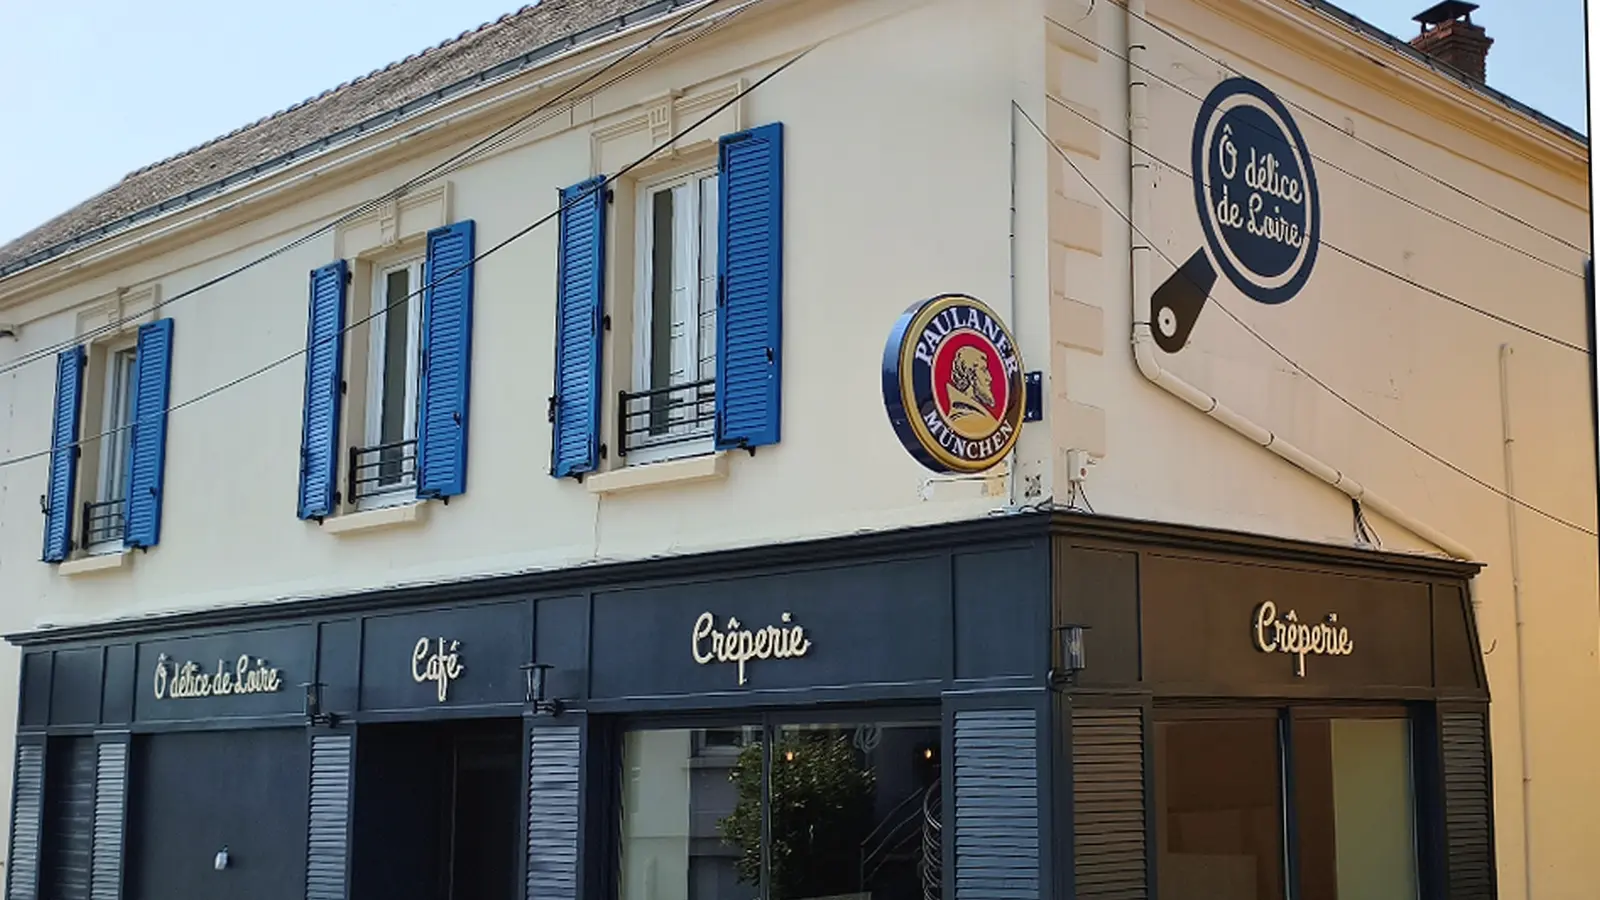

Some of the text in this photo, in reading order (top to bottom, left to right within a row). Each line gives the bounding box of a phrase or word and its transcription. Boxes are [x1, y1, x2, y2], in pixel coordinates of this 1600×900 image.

[1218, 123, 1303, 205] Ô délice
[1216, 184, 1305, 249] de Loire
[915, 306, 1020, 379] PAULANER
[923, 409, 1014, 460] MÜNCHEN
[411, 636, 465, 702] Café
[691, 611, 812, 686] Crêperie
[1257, 600, 1354, 678] Crêperie
[153, 652, 282, 700] Ô délice de Loire
